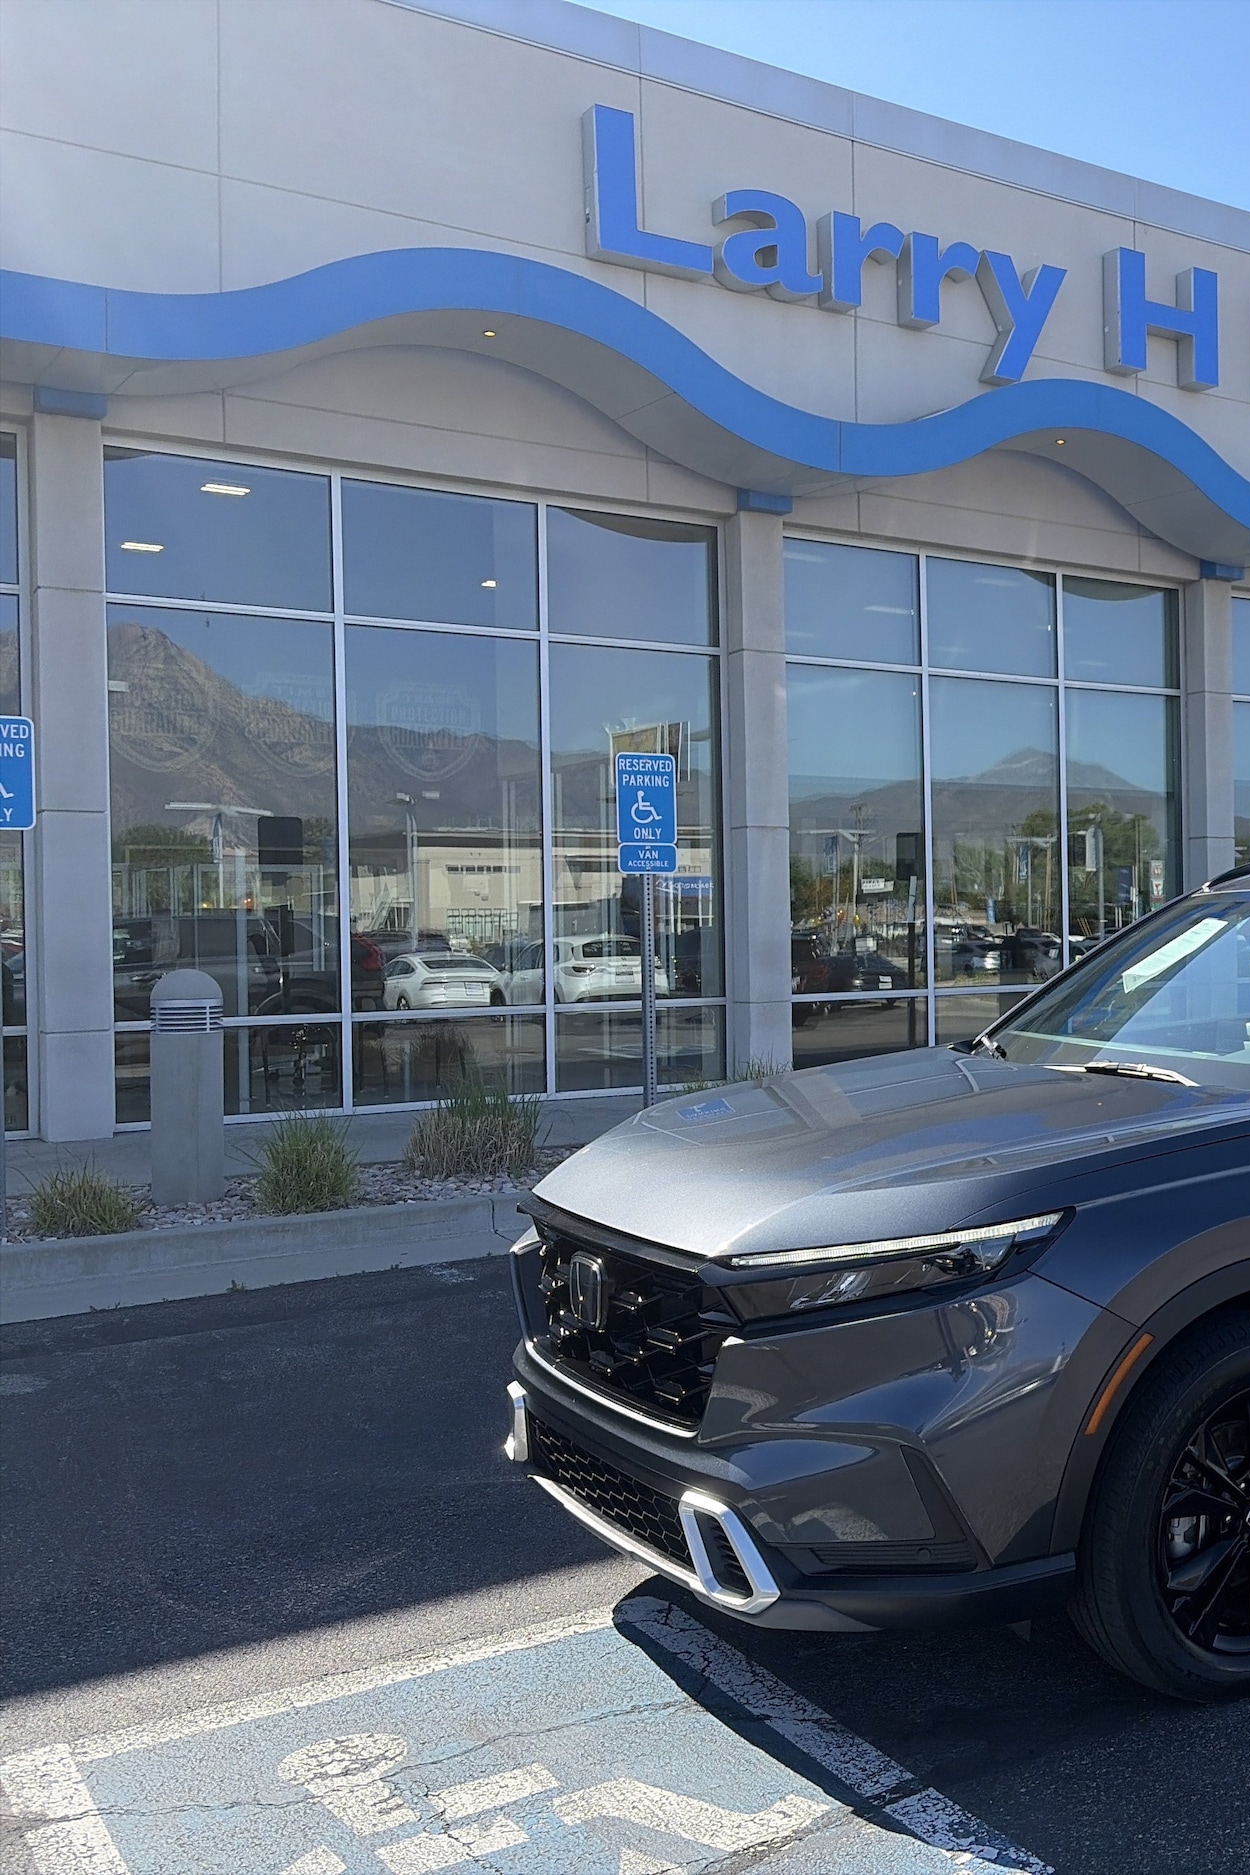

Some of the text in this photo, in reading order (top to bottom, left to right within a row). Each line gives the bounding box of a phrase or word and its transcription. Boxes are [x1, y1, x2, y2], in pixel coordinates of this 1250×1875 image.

[584, 104, 1068, 385] Larry
[1104, 246, 1218, 391] H
[618, 758, 672, 772] RESERVED
[622, 774, 669, 787] PARKING
[633, 827, 662, 840] ONLY
[638, 850, 659, 859] VAN
